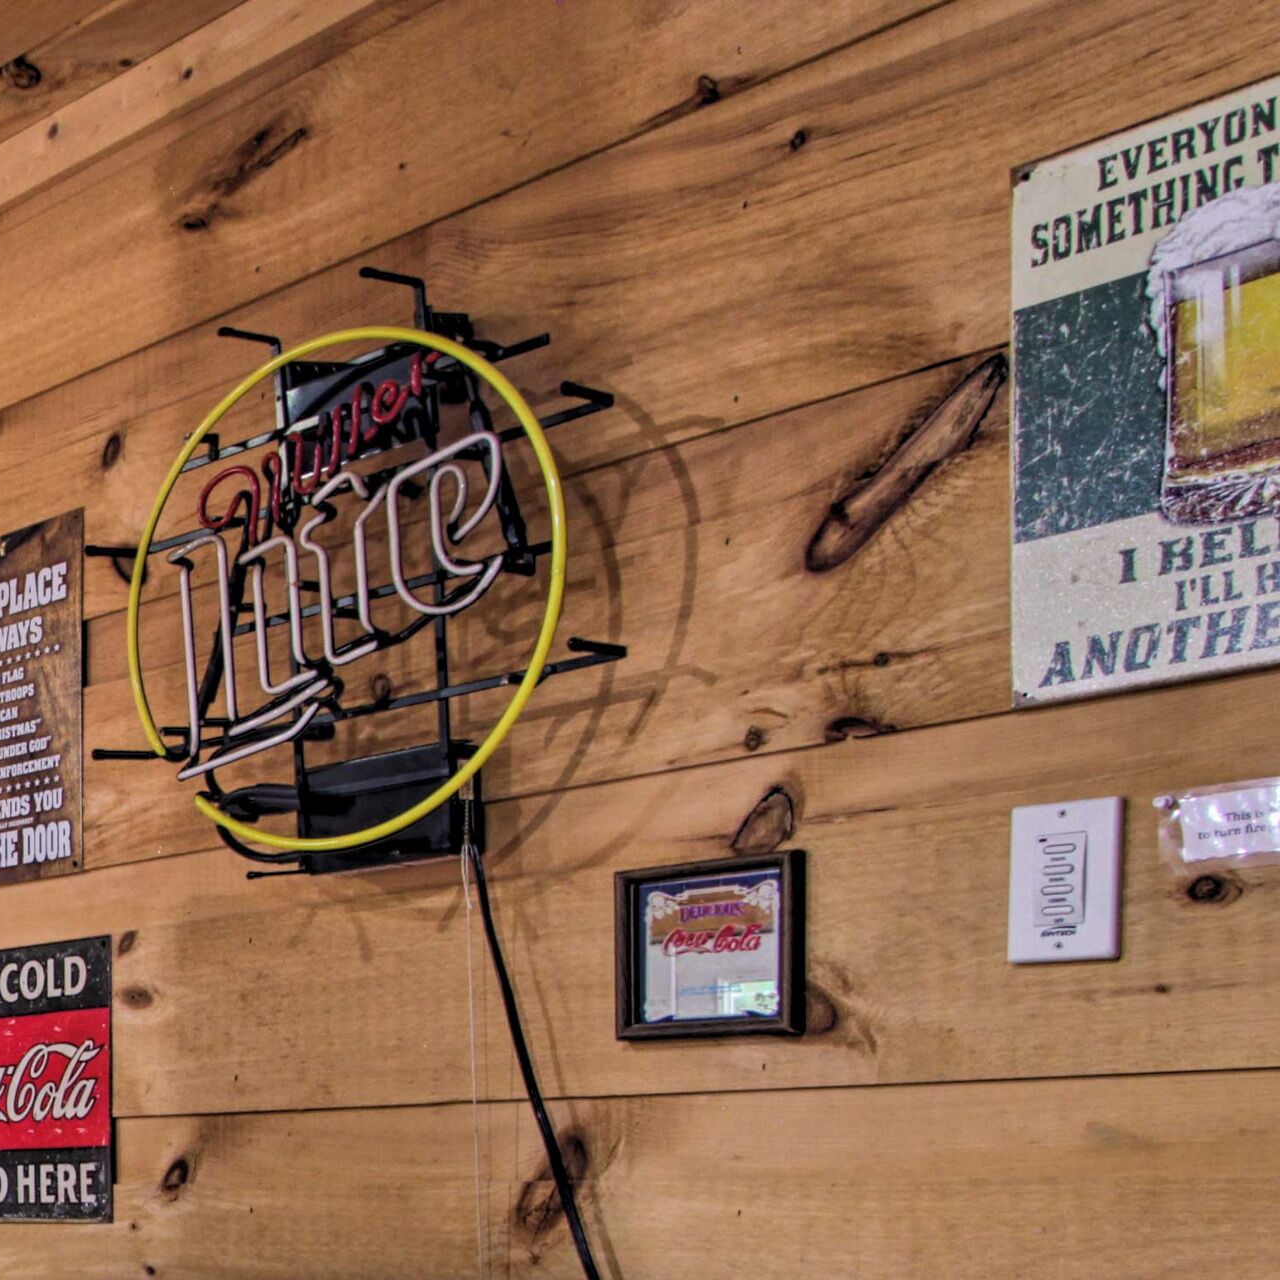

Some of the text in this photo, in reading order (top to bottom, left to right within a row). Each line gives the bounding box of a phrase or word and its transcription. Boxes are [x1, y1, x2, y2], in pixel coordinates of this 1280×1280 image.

[1097, 97, 1278, 192] EVERYON
[1030, 155, 1245, 268] SOMETHING
[199, 348, 439, 546] Miller
[1118, 547, 1138, 584] I
[168, 431, 502, 781] Lite
[1175, 570, 1243, 611] I'LL
[0, 683, 35, 703] TROOPS
[2, 667, 24, 684] FLAG
[33, 787, 63, 813] YOU
[1225, 811, 1251, 822] This
[22, 820, 71, 865] DOOR
[1198, 831, 1210, 840] to
[1215, 828, 1241, 838] turn
[0, 955, 87, 1002] COLD
[17, 1162, 96, 1204] HERE
